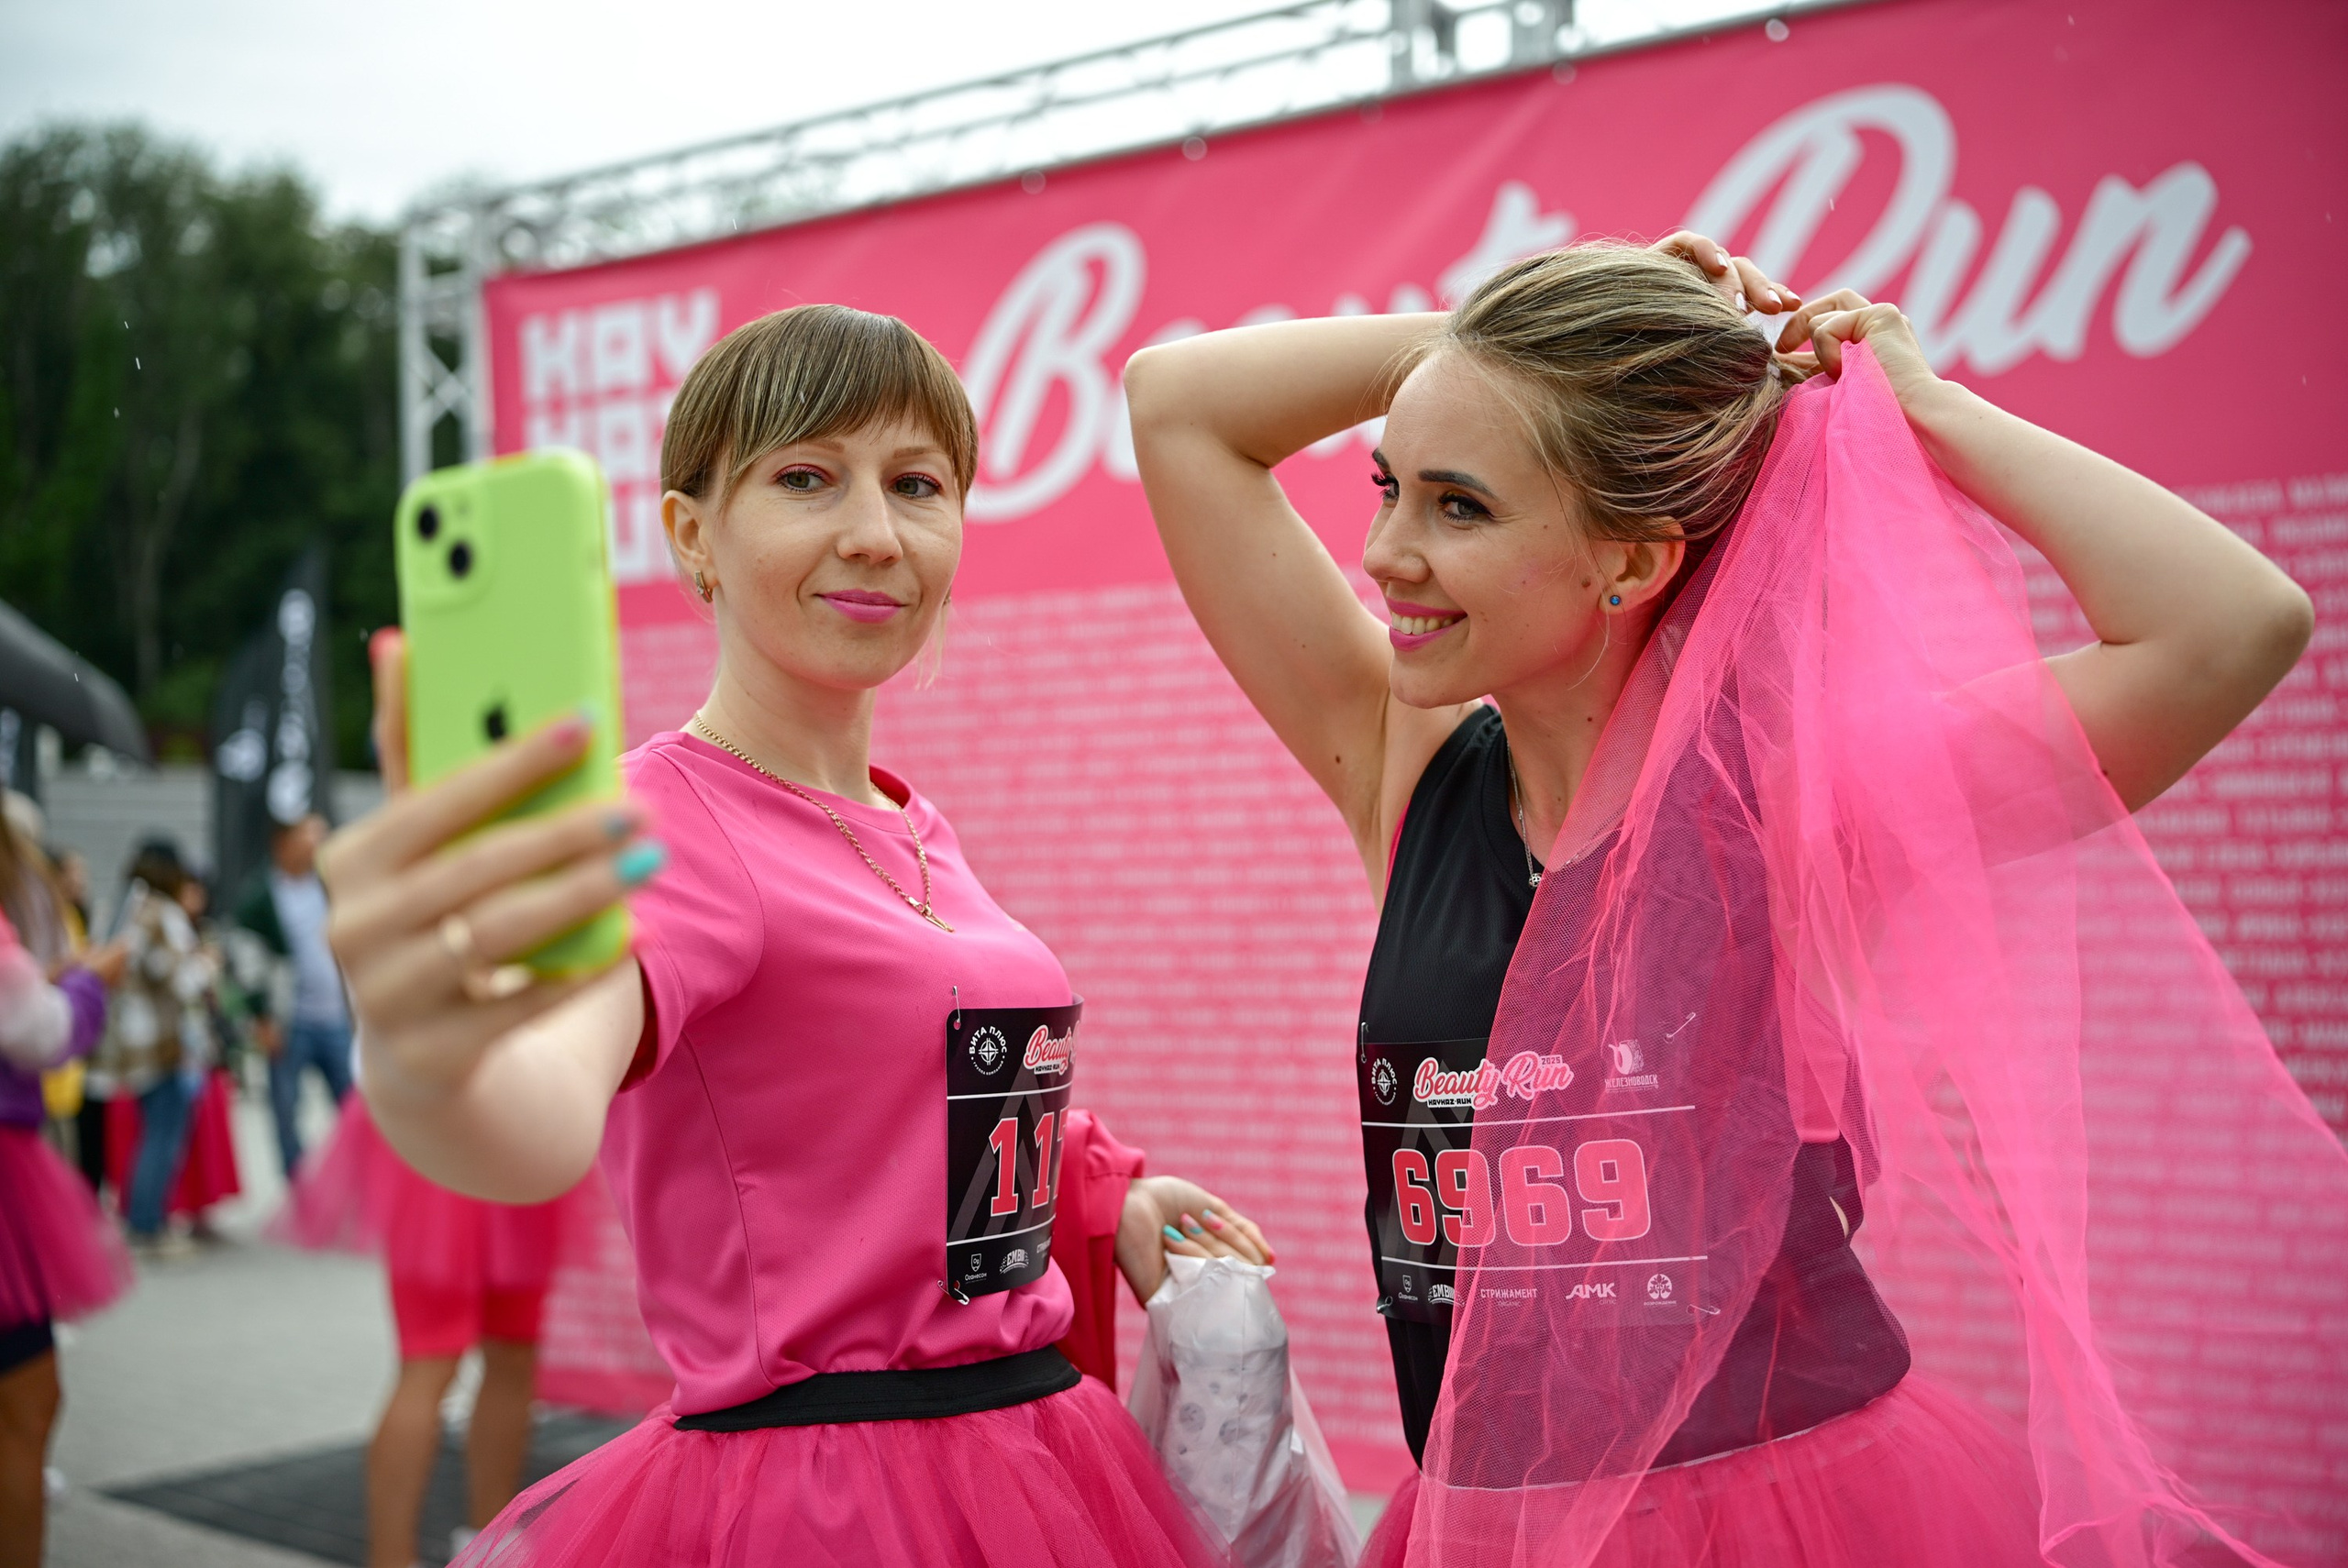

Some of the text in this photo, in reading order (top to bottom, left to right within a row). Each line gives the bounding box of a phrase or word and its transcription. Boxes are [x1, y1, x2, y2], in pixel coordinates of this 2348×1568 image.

[969, 1025, 1008, 1055] ВИТА ПЛЮС
[1371, 1057, 1398, 1085] ВИТА ПЛЮС
[1541, 1056, 1561, 1066] 2025
[1412, 1051, 1574, 1110] Beauty Run
[1604, 1074, 1658, 1088] ЖЕЛЕЗНОВОДСК
[1391, 1138, 1652, 1248] 6969
[1480, 1288, 1537, 1298] СТРИЖАМЕНТ
